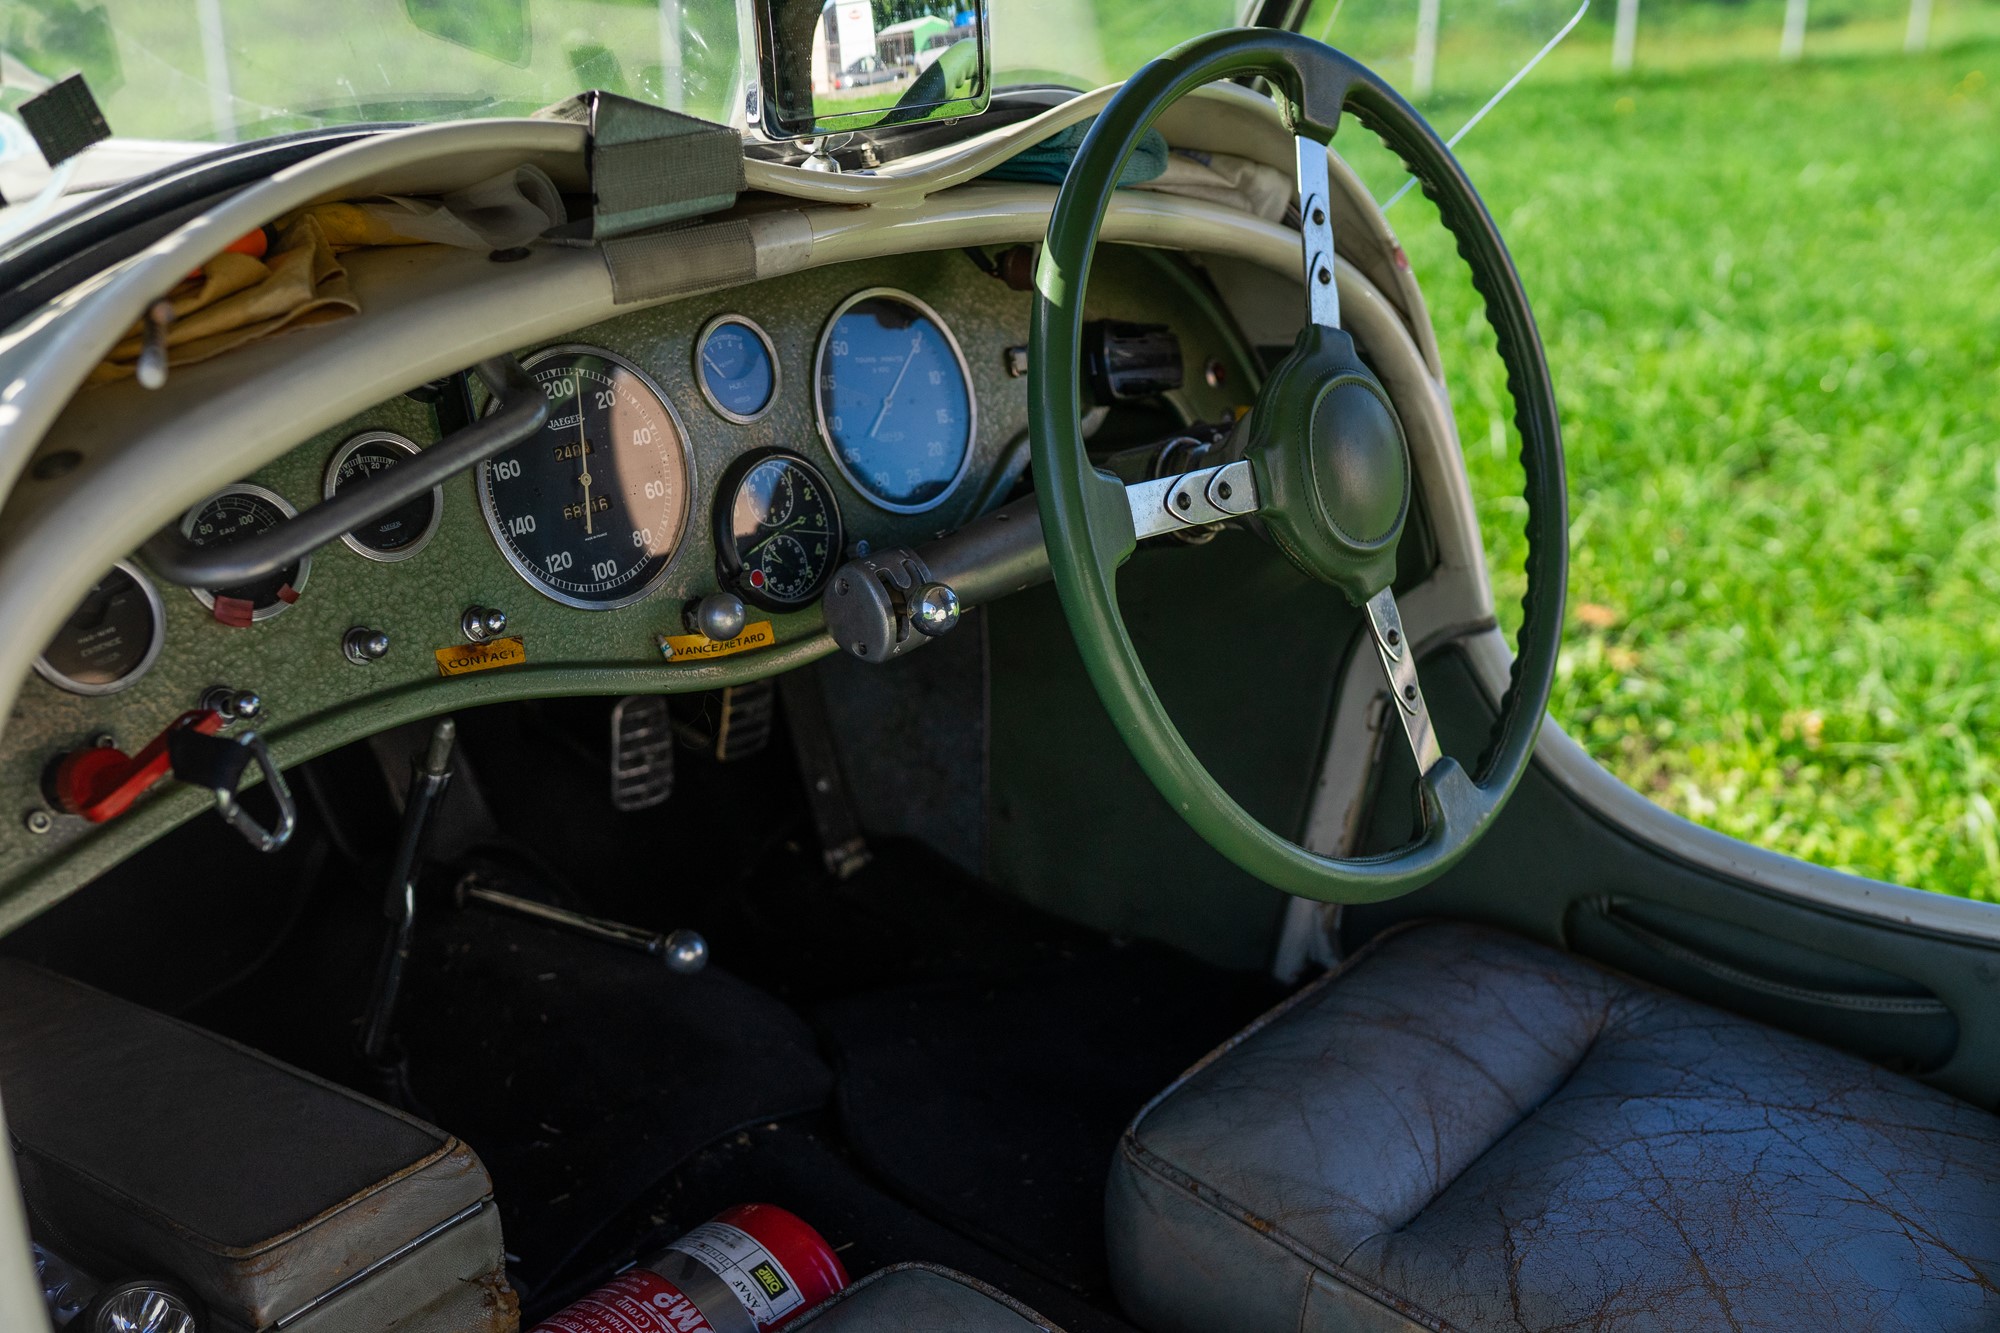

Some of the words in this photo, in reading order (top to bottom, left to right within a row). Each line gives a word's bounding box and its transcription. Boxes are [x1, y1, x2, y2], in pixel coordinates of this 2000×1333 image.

[833, 340, 847, 355] 50
[929, 370, 940, 384] 10
[543, 378, 573, 400] 200
[595, 390, 616, 409] 20
[936, 408, 947, 424] 15
[633, 428, 650, 446] 40
[927, 441, 941, 457] 20
[344, 467, 354, 477] 20
[493, 459, 521, 481] 160
[645, 480, 664, 500] 60
[803, 487, 811, 500] 2
[200, 523, 213, 535] 80
[238, 514, 254, 526] 100
[508, 514, 536, 537] 140
[815, 513, 823, 526] 3
[219, 526, 236, 536] EAU
[632, 528, 652, 548] 80
[815, 542, 822, 555] 4
[545, 551, 573, 573] 120
[592, 559, 617, 581] 100
[674, 632, 764, 655] VANCE/RETARD
[448, 648, 516, 668] CONTACT
[756, 1268, 782, 1293] OMP
[732, 1280, 762, 1309] ANAF
[615, 1299, 650, 1328] Group
